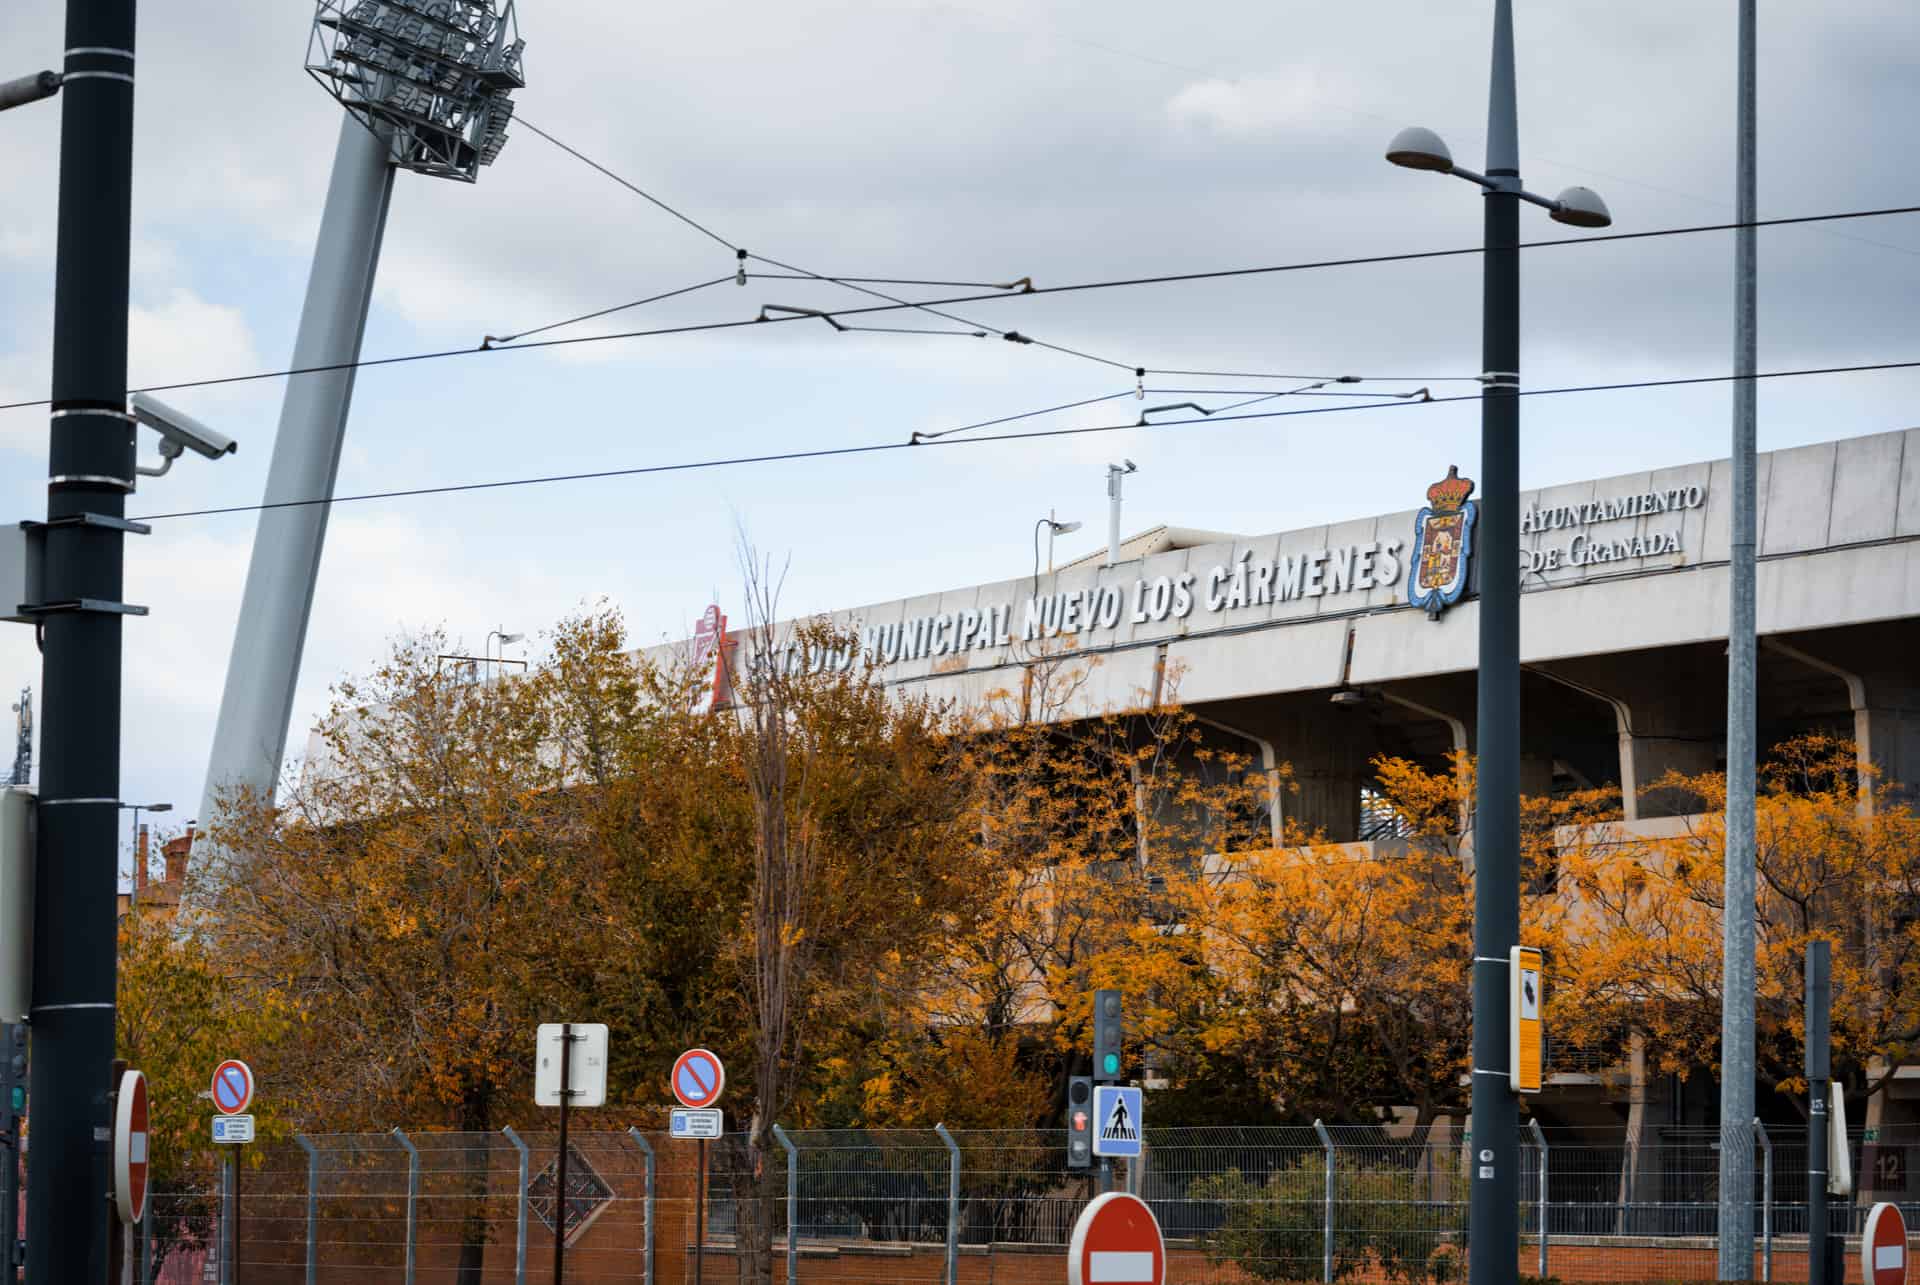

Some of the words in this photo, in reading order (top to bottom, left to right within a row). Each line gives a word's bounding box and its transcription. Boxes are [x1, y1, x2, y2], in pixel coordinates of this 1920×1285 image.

[1520, 487, 1705, 534] AYUNTAMIENTO
[856, 603, 1011, 668] MUNICIPAL
[1024, 585, 1122, 641] NUEVO
[1131, 572, 1194, 624] LOS
[1206, 538, 1401, 612] CÁRMENES
[1876, 1155, 1898, 1180] 12
